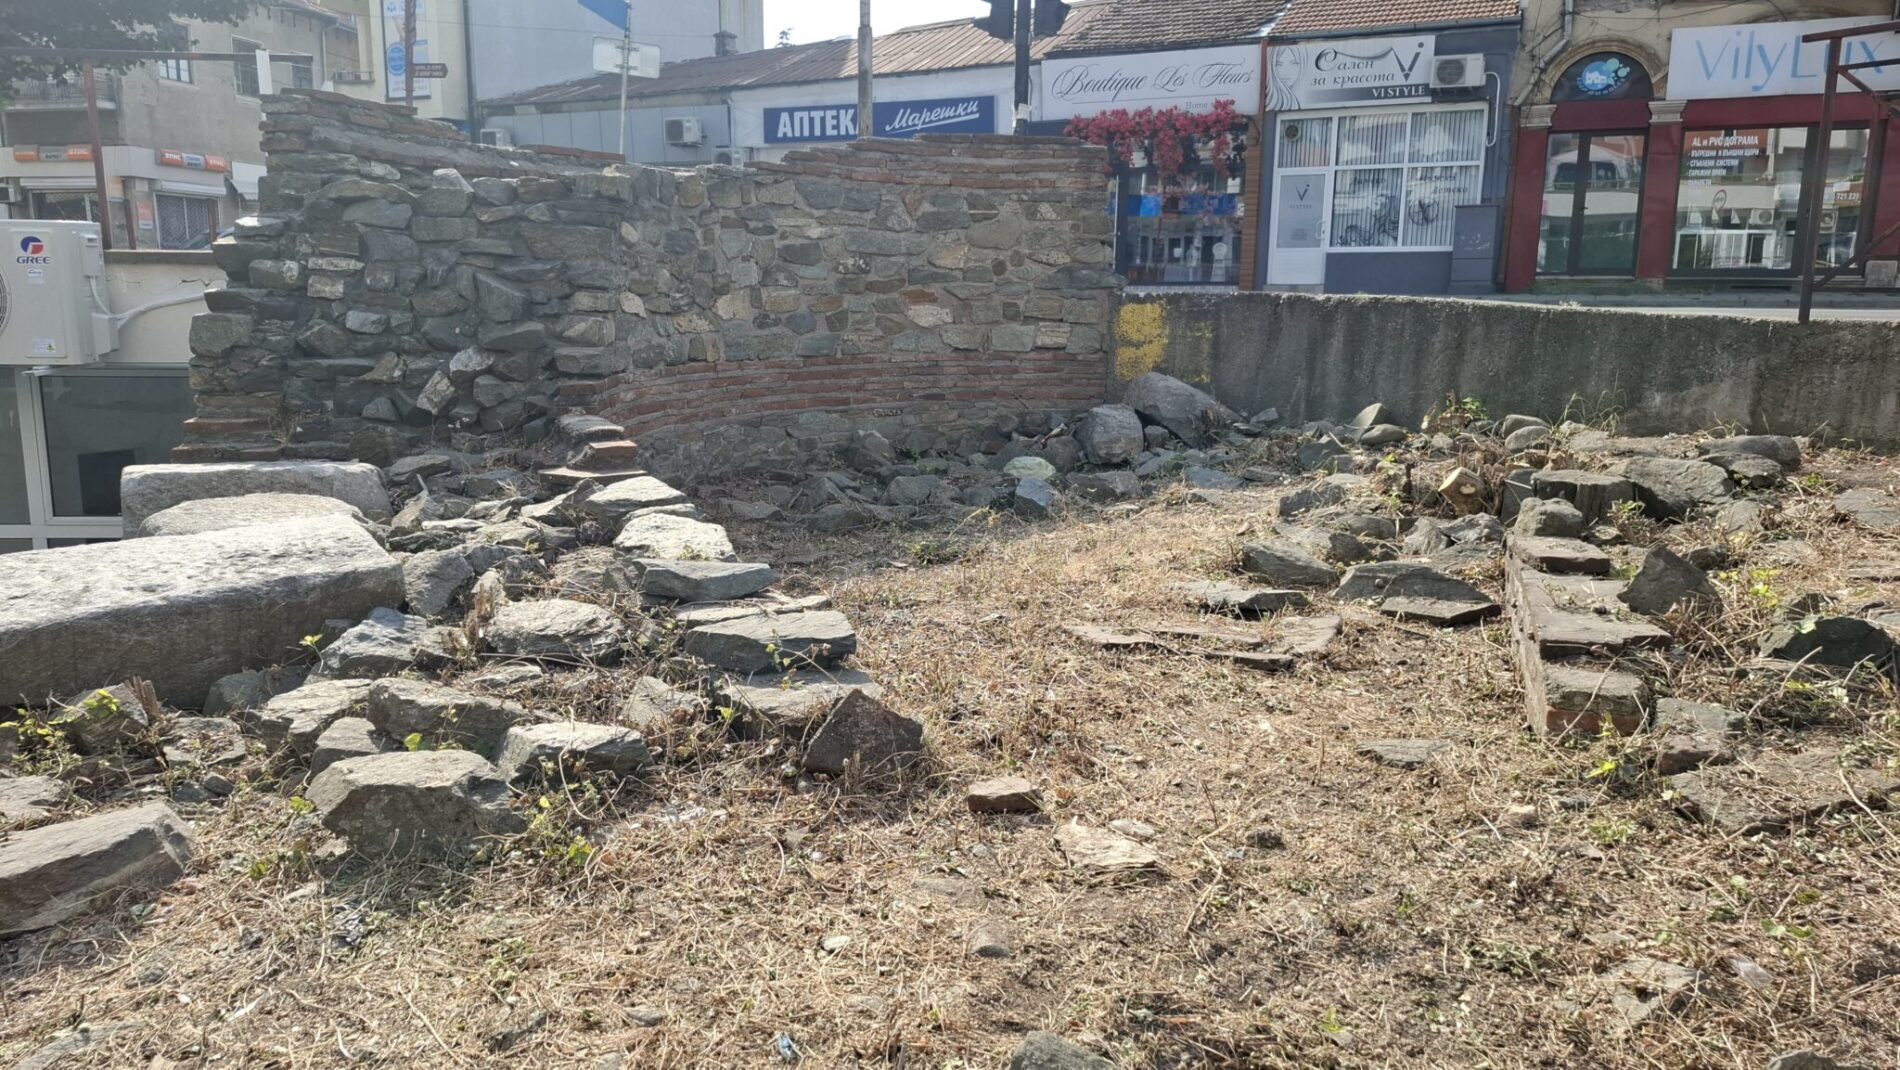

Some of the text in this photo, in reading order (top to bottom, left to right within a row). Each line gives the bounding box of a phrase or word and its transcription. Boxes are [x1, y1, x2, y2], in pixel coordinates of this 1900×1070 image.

[1314, 47, 1374, 72] Салон
[1051, 58, 1255, 102] Boutique Les Fleurs
[1311, 72, 1396, 88] за красота
[1372, 85, 1425, 98] VI STYLE
[1186, 101, 1209, 110] Home
[885, 100, 980, 129] Марешки
[777, 108, 859, 138] АПТЕК
[1692, 137, 1701, 147] AL
[1709, 136, 1724, 146] PVC
[1724, 135, 1759, 147] ДОГРАМА
[1716, 159, 1739, 167] СИСТЕМИ
[16, 256, 51, 264] GREE
